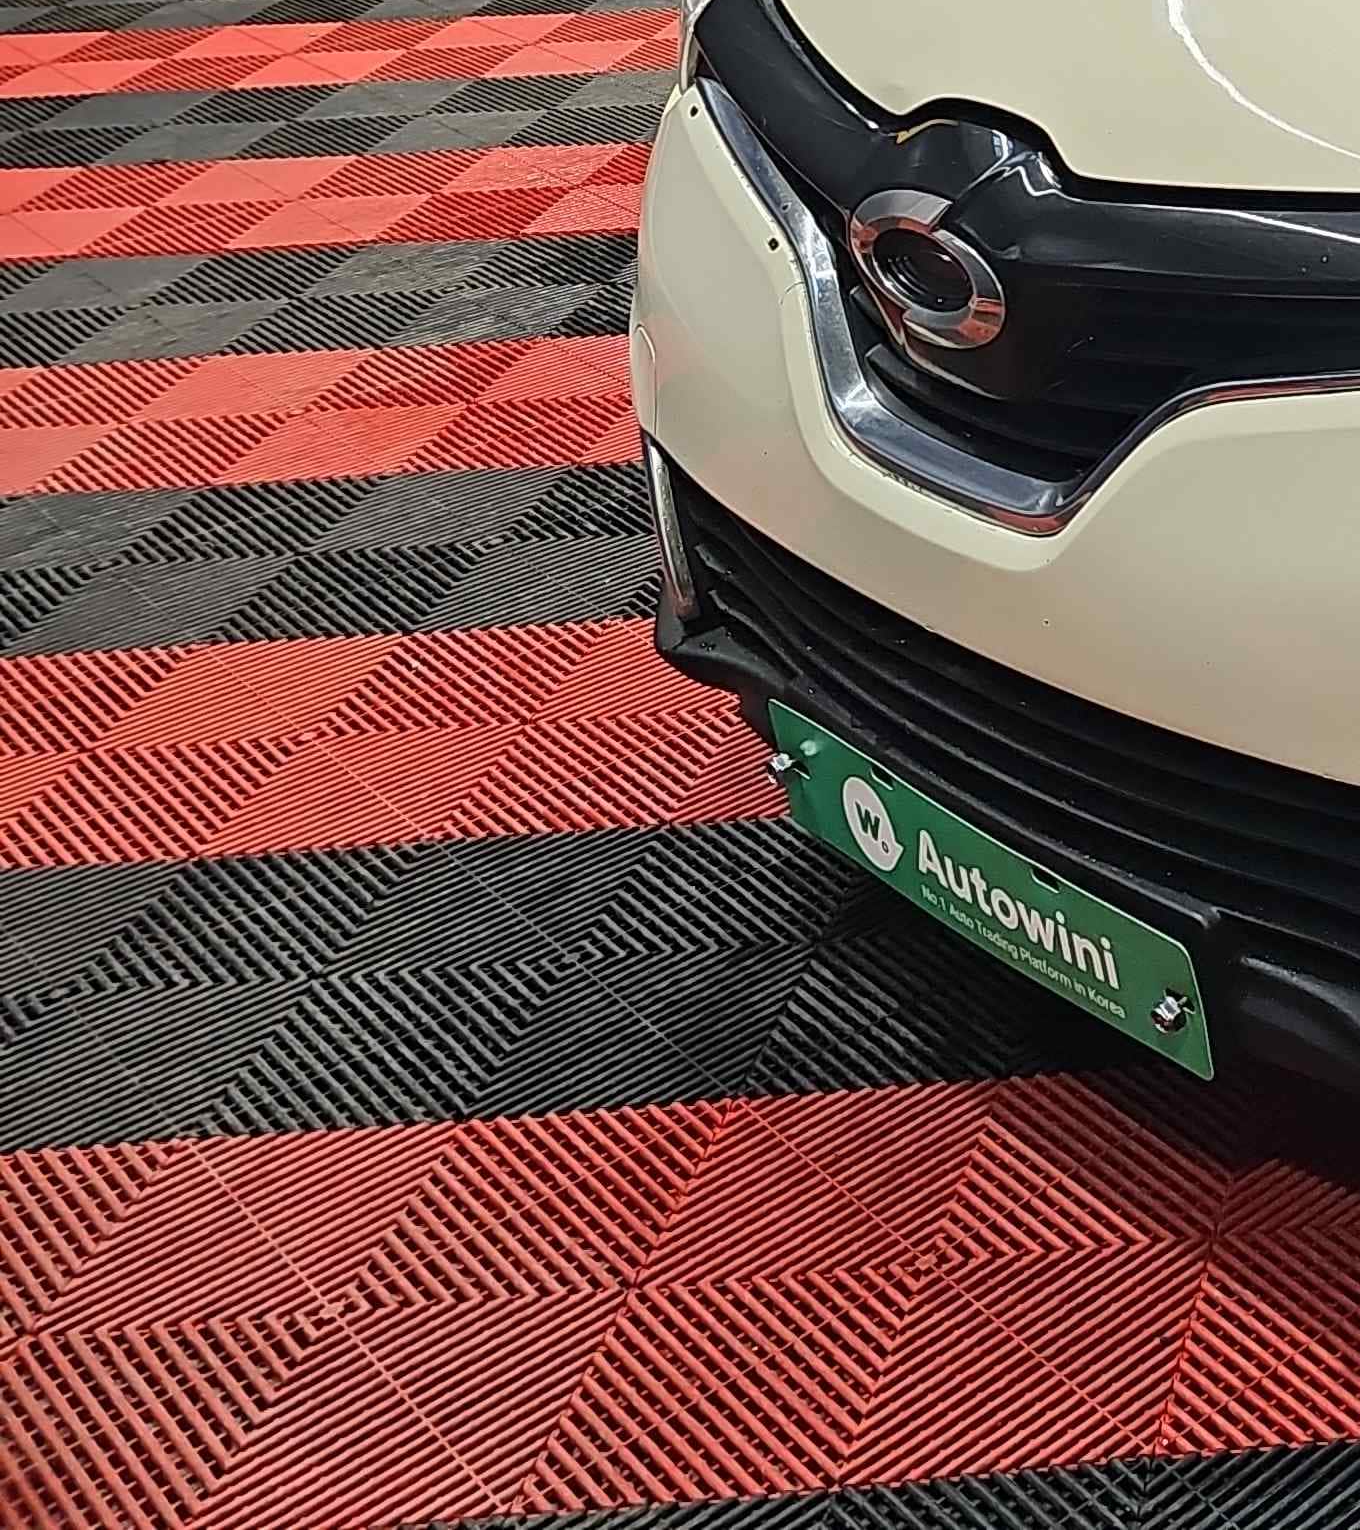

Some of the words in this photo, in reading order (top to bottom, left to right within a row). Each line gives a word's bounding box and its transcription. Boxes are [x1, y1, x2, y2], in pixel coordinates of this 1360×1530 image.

[918, 829, 1120, 990] Autowini
[975, 918, 1020, 960] Trading
[1019, 946, 1073, 988] Platform
[1073, 978, 1087, 997] in
[1087, 985, 1126, 1020] Korea
